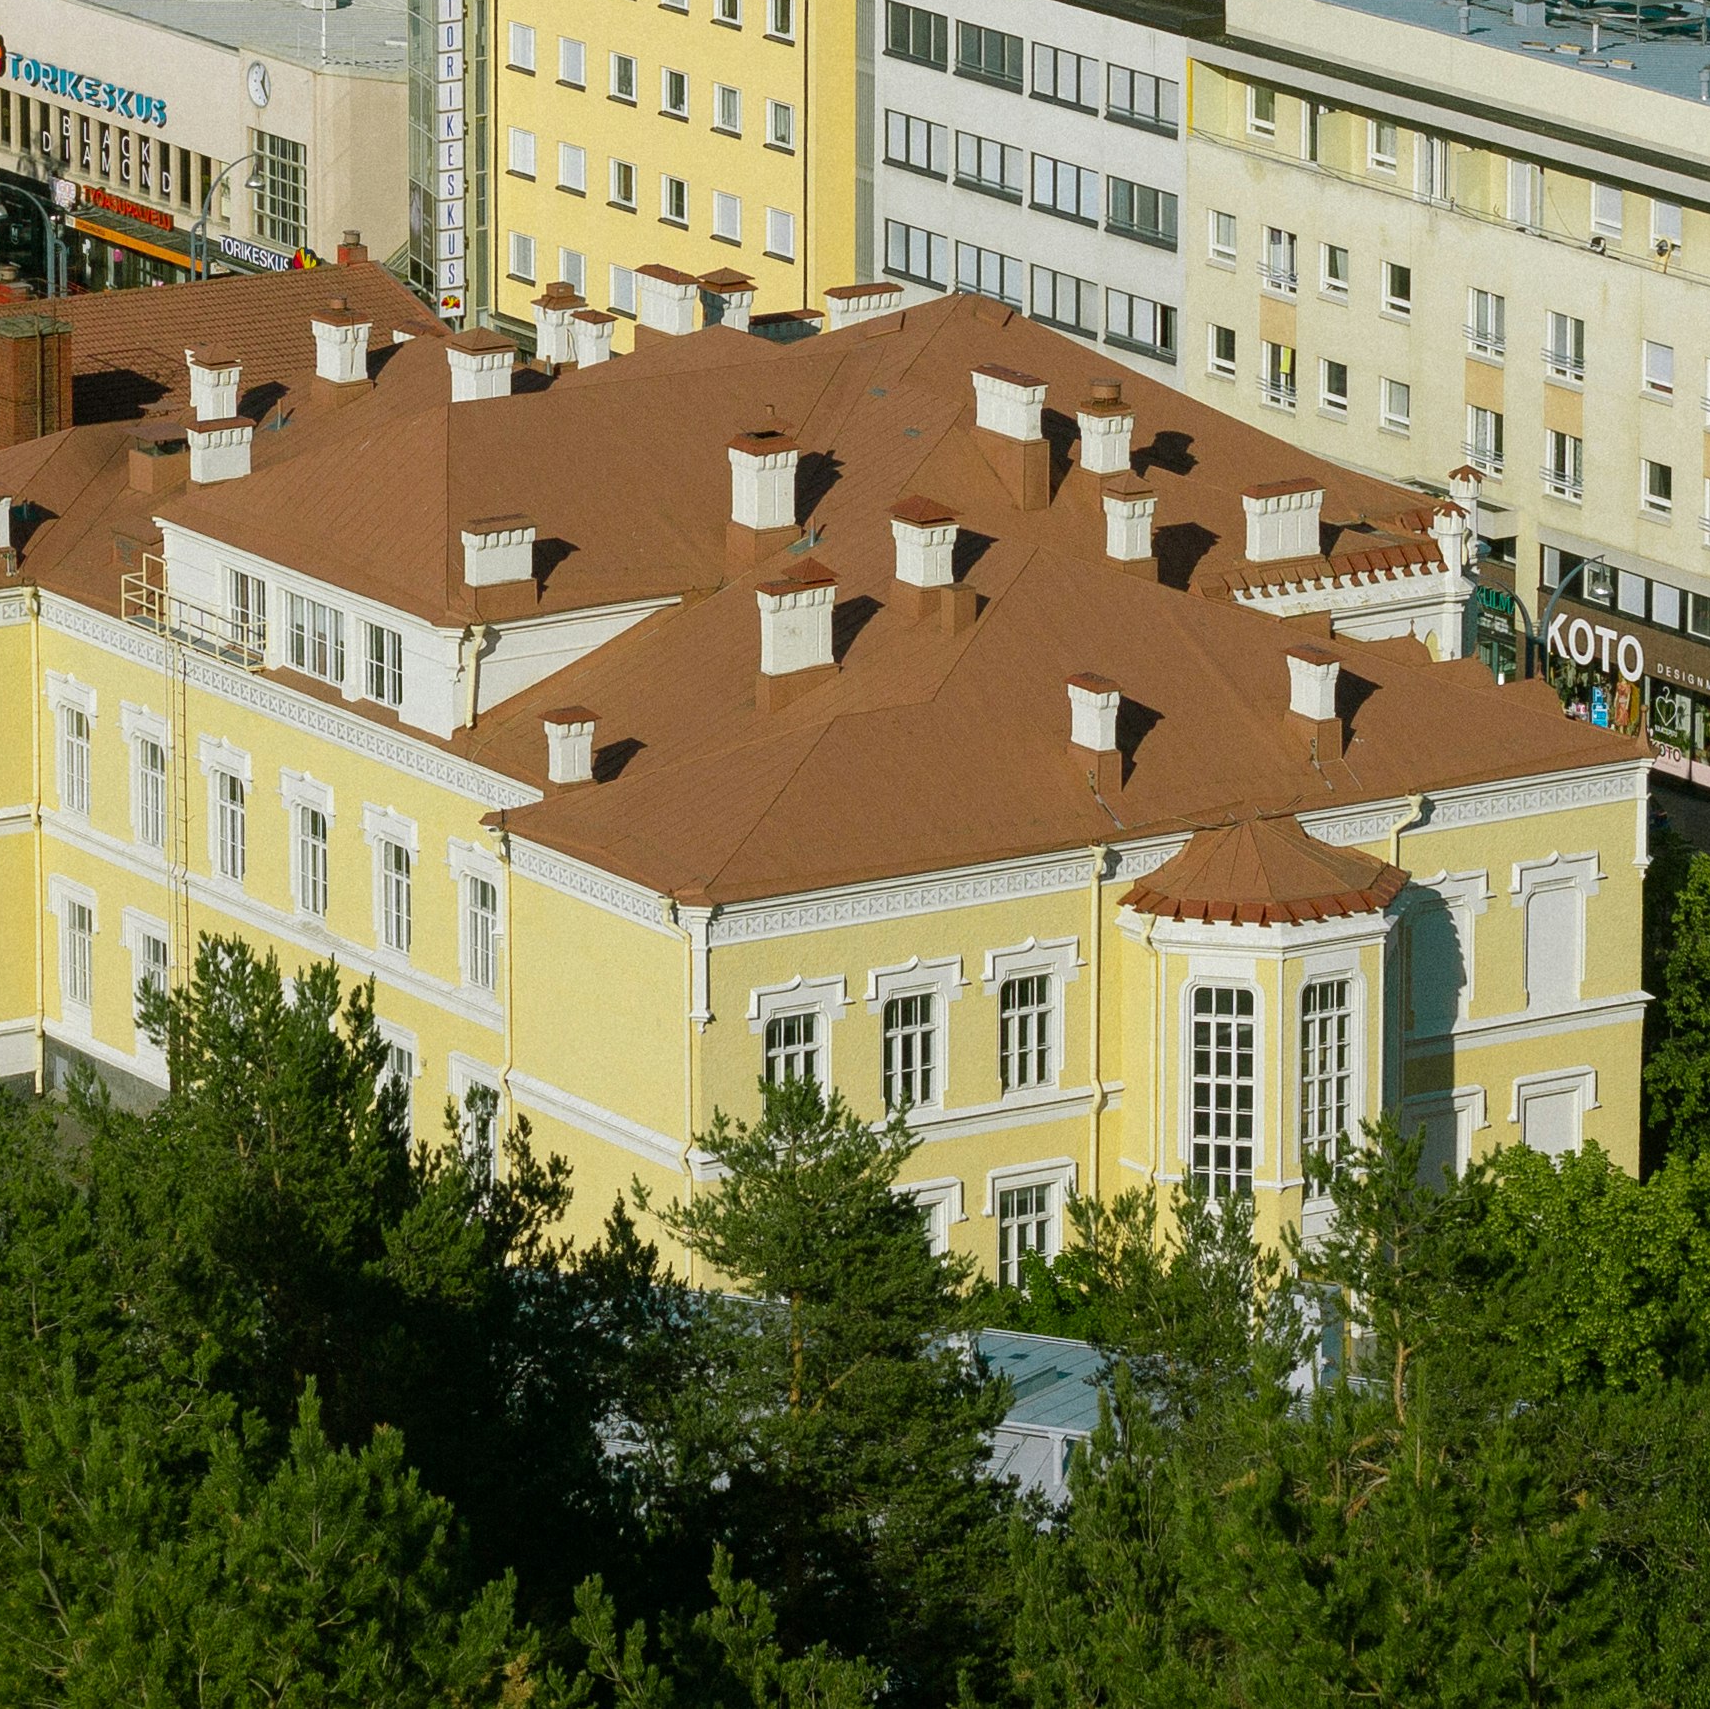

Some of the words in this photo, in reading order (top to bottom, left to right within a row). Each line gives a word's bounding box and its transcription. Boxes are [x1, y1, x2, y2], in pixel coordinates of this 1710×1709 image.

[5, 52, 168, 128] TORIKESKUS
[42, 130, 171, 193] DIAMOND
[62, 115, 150, 163] BLACK
[219, 235, 289, 272] TORIKESKUS
[1547, 612, 1644, 683] KOTO
